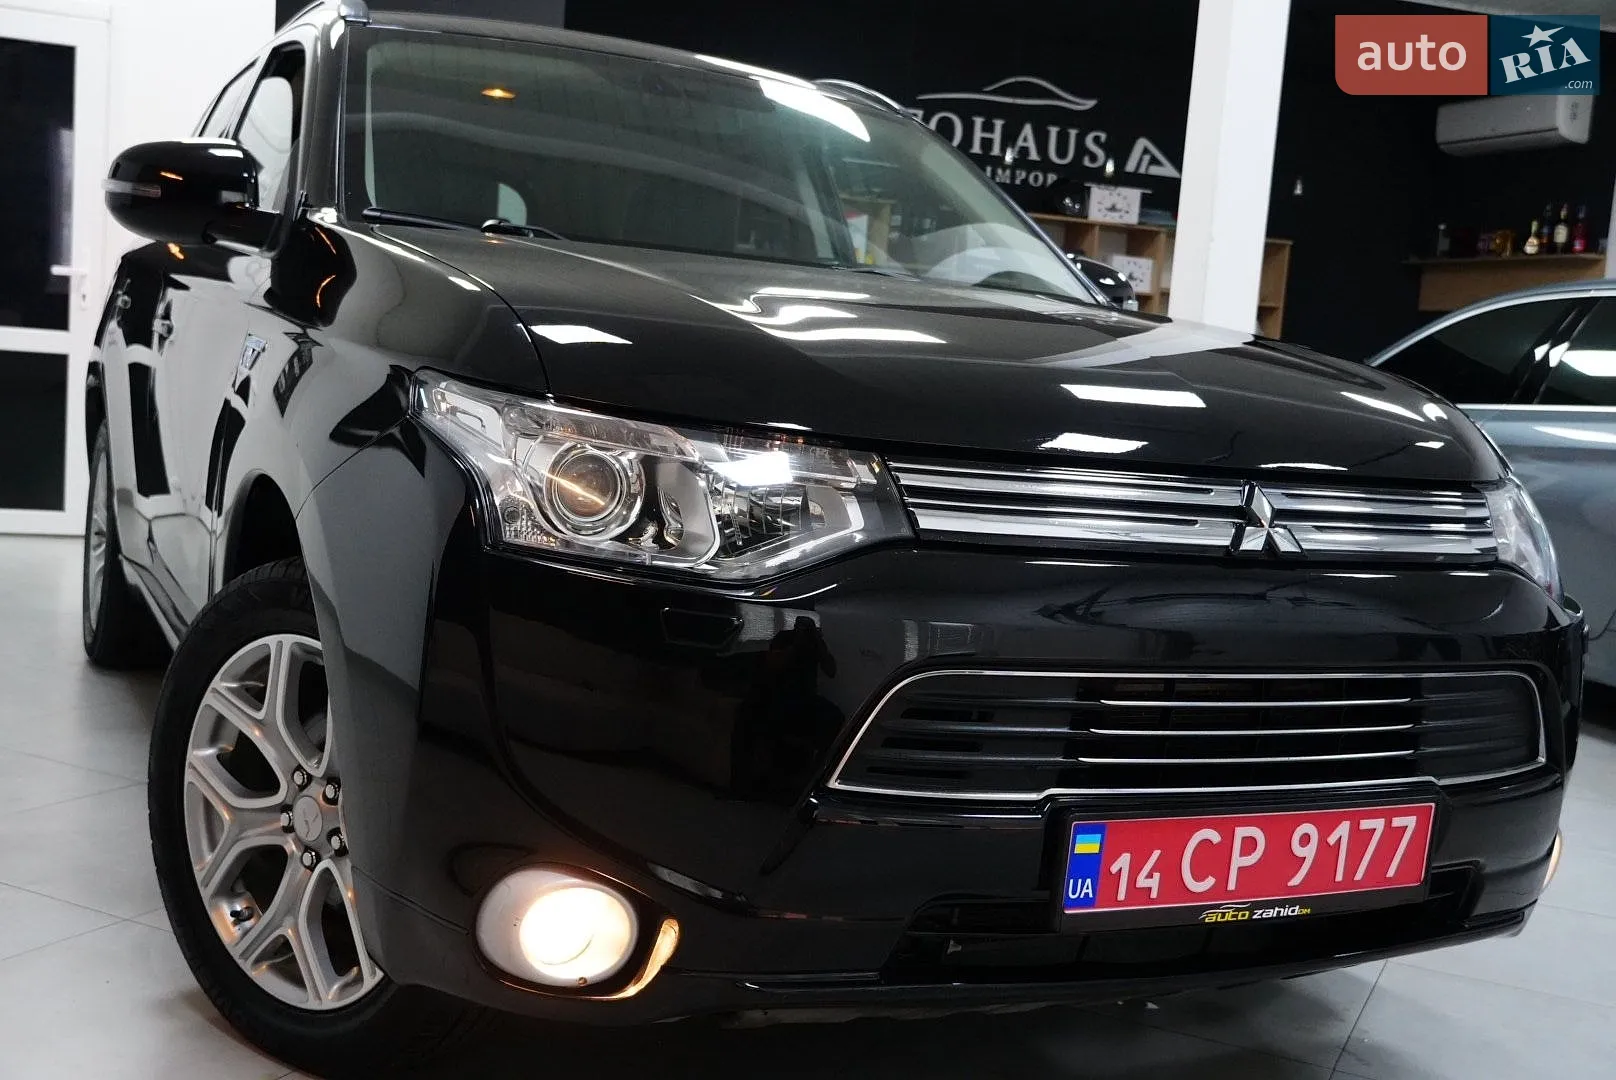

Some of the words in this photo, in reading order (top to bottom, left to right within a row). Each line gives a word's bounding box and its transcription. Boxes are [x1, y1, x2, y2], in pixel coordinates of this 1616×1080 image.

[1109, 849, 1162, 901] 14
[1181, 826, 1266, 894] CP
[1287, 815, 1417, 888] 9177
[1068, 878, 1093, 899] UA
[1204, 910, 1249, 922] auto
